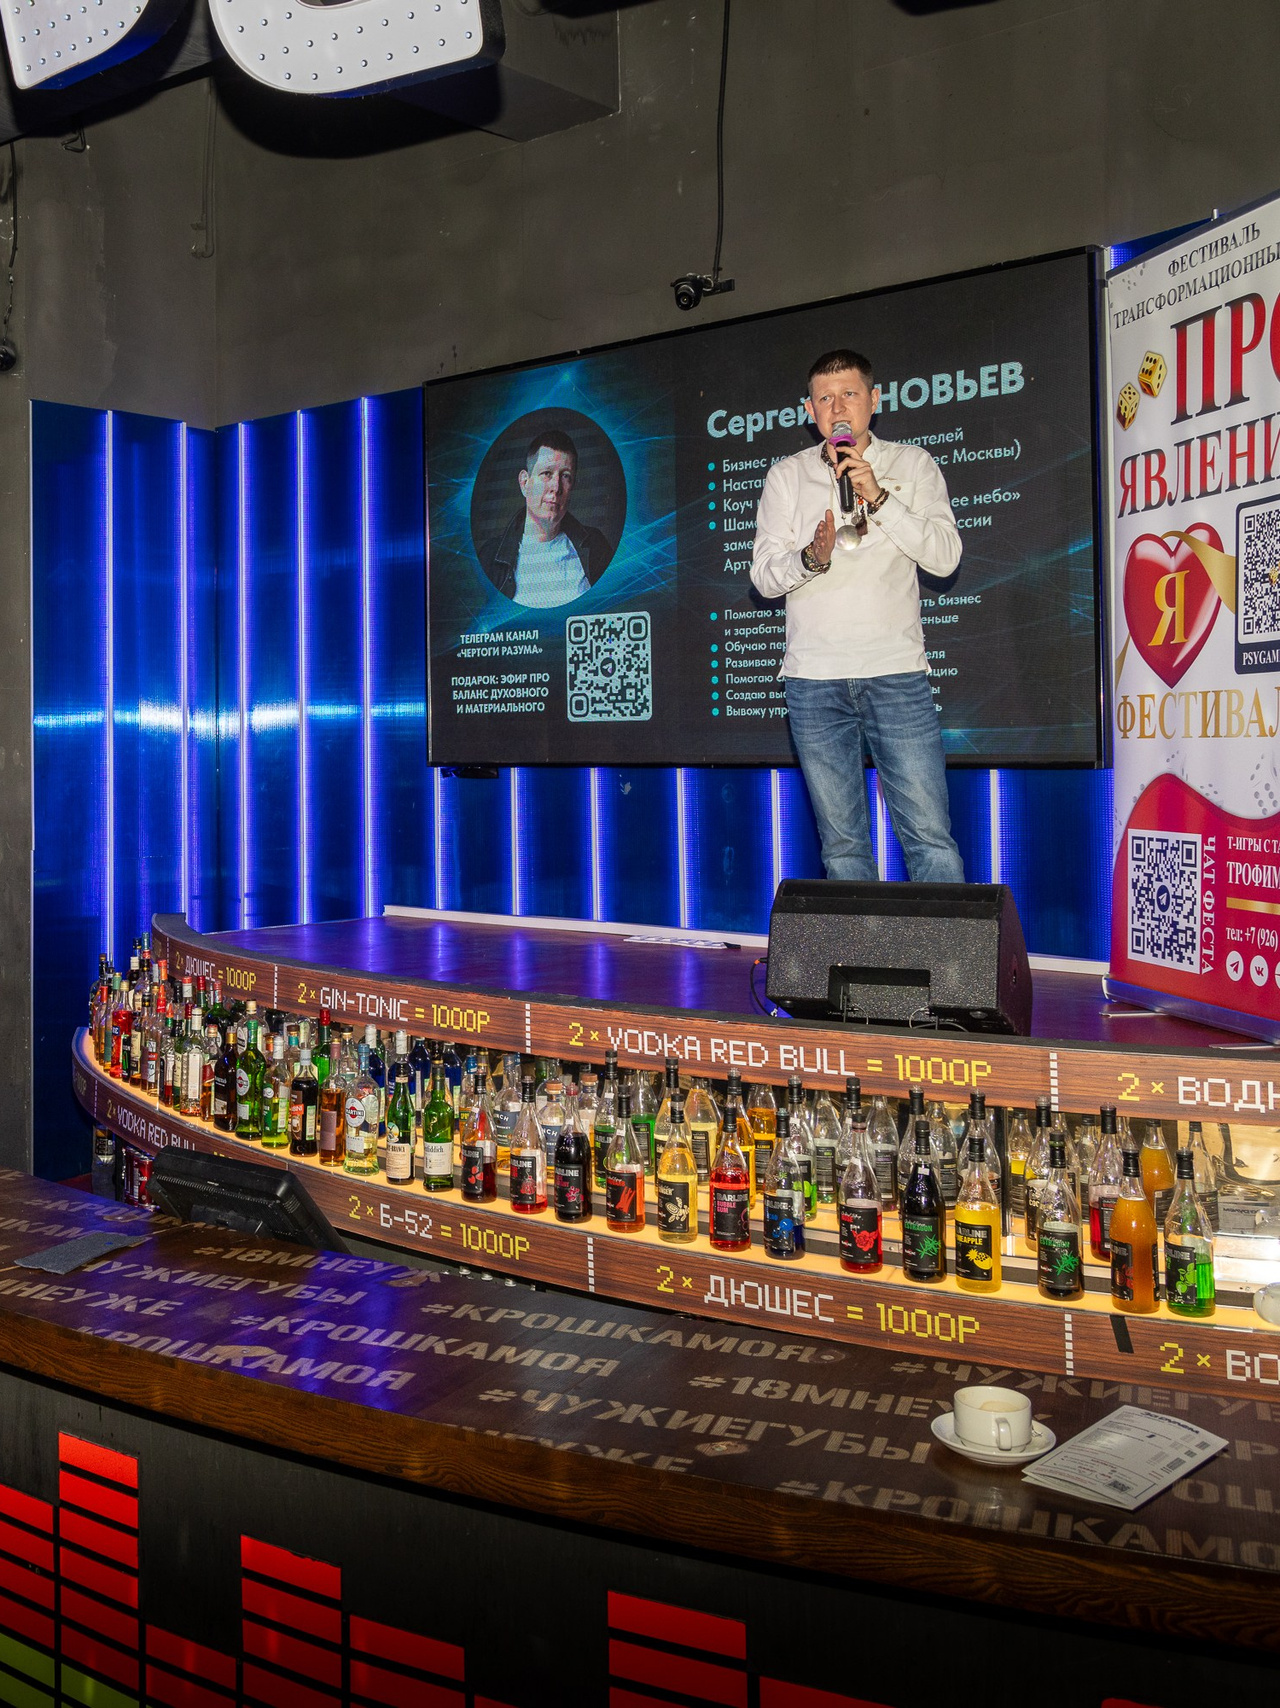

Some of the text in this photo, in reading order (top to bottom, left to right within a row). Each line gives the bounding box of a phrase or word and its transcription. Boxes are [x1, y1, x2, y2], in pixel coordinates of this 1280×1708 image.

[1167, 221, 1261, 278] ФЕСТИВАЛЬ
[1170, 290, 1280, 426] ПР
[952, 438, 1021, 465] Москвы)
[722, 457, 767, 473] Бизнес
[973, 488, 1021, 505] небо»
[723, 499, 753, 514] Коуч
[724, 609, 772, 620] Помогаю
[938, 595, 982, 606] бизнес
[1148, 570, 1190, 647] Я
[460, 630, 539, 644] ТЕЛЕГРАМ КАНАЛ
[724, 628, 731, 636] и
[457, 644, 543, 658] «ЧЕРТОГИ РАЗУМА»
[724, 641, 767, 654] Обучаю
[725, 657, 776, 668] Развиваю
[451, 672, 550, 687] ПОДАРОК: ЭФИР ПРО
[725, 673, 773, 684] Помогаю
[453, 687, 549, 701] БАЛАНС ДУХОВНОГО
[726, 689, 766, 701] Создаю
[457, 702, 546, 713] И МАТЕРИАЛЬНОГО
[726, 705, 767, 718] Вывожу
[1227, 836, 1262, 852] Т-ИГРЫ
[1263, 838, 1270, 853] С
[1201, 836, 1216, 975] ЧАТ ФЕСТА
[1225, 926, 1279, 952] тел: +7 (926)
[320, 986, 408, 1022] GIN-TONIC
[606, 1026, 701, 1061] VODKA
[710, 1038, 769, 1068] RED
[779, 1044, 856, 1077] BULL
[117, 1104, 146, 1140] VODKA
[148, 1122, 168, 1148] RED
[704, 1274, 835, 1323] ДЮШЕС
[420, 1302, 820, 1365] #КРОШКАМОЯ
[230, 1314, 621, 1378] #КРОШКАМОЯ
[478, 1388, 931, 1465] #ЧУЖИЕГУБЫ
